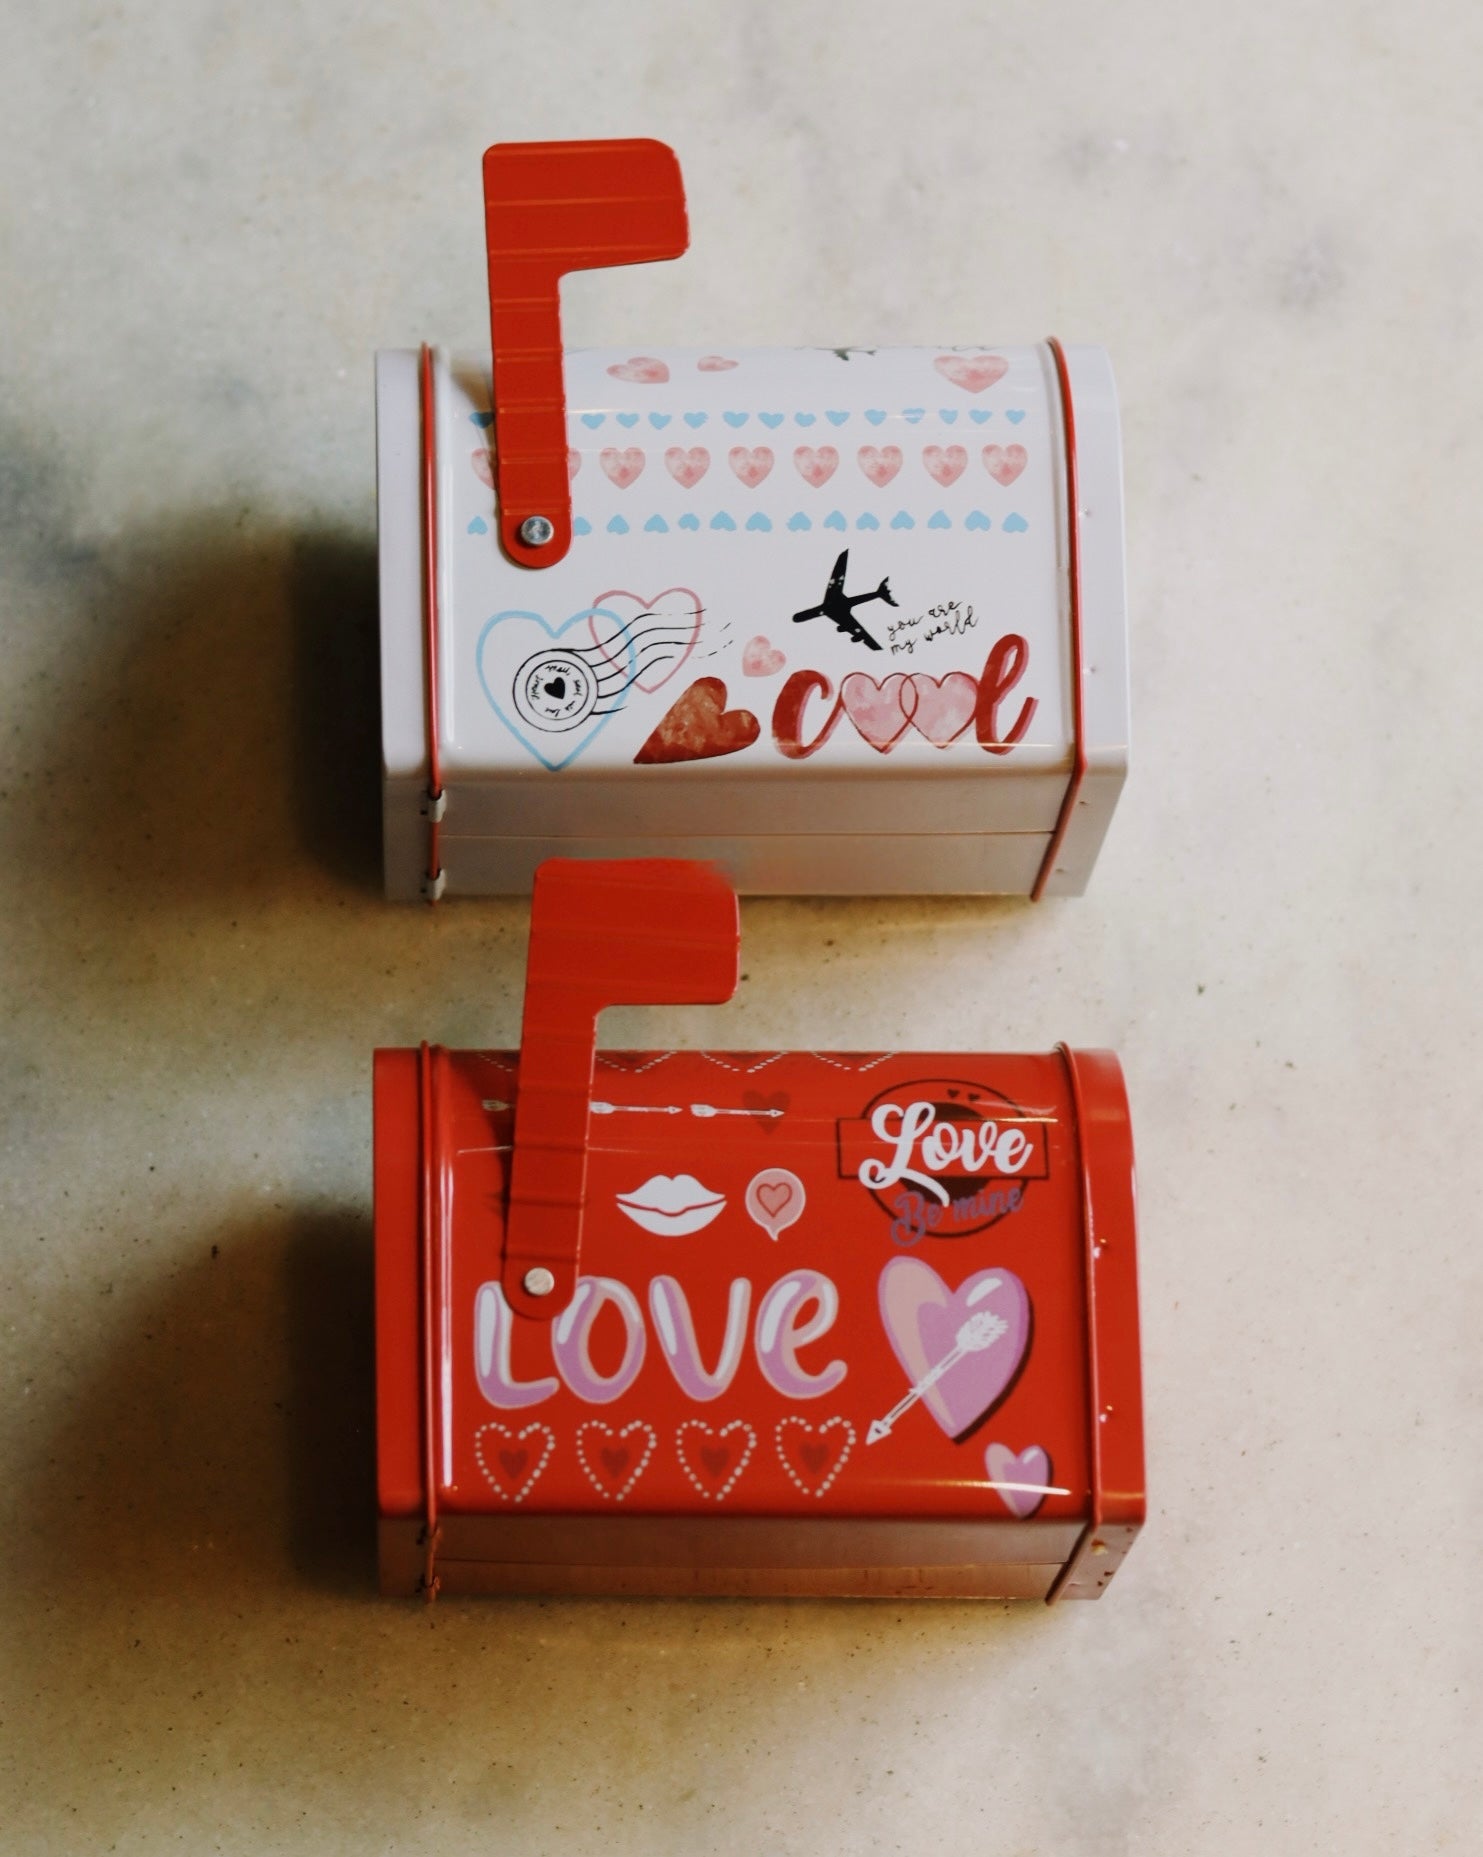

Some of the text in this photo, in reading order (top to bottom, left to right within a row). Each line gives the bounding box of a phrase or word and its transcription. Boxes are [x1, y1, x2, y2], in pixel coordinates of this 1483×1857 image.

[887, 601, 963, 641] you are
[890, 605, 980, 656] my world
[858, 1101, 1034, 1208] Love
[891, 1186, 1024, 1247] Be mine
